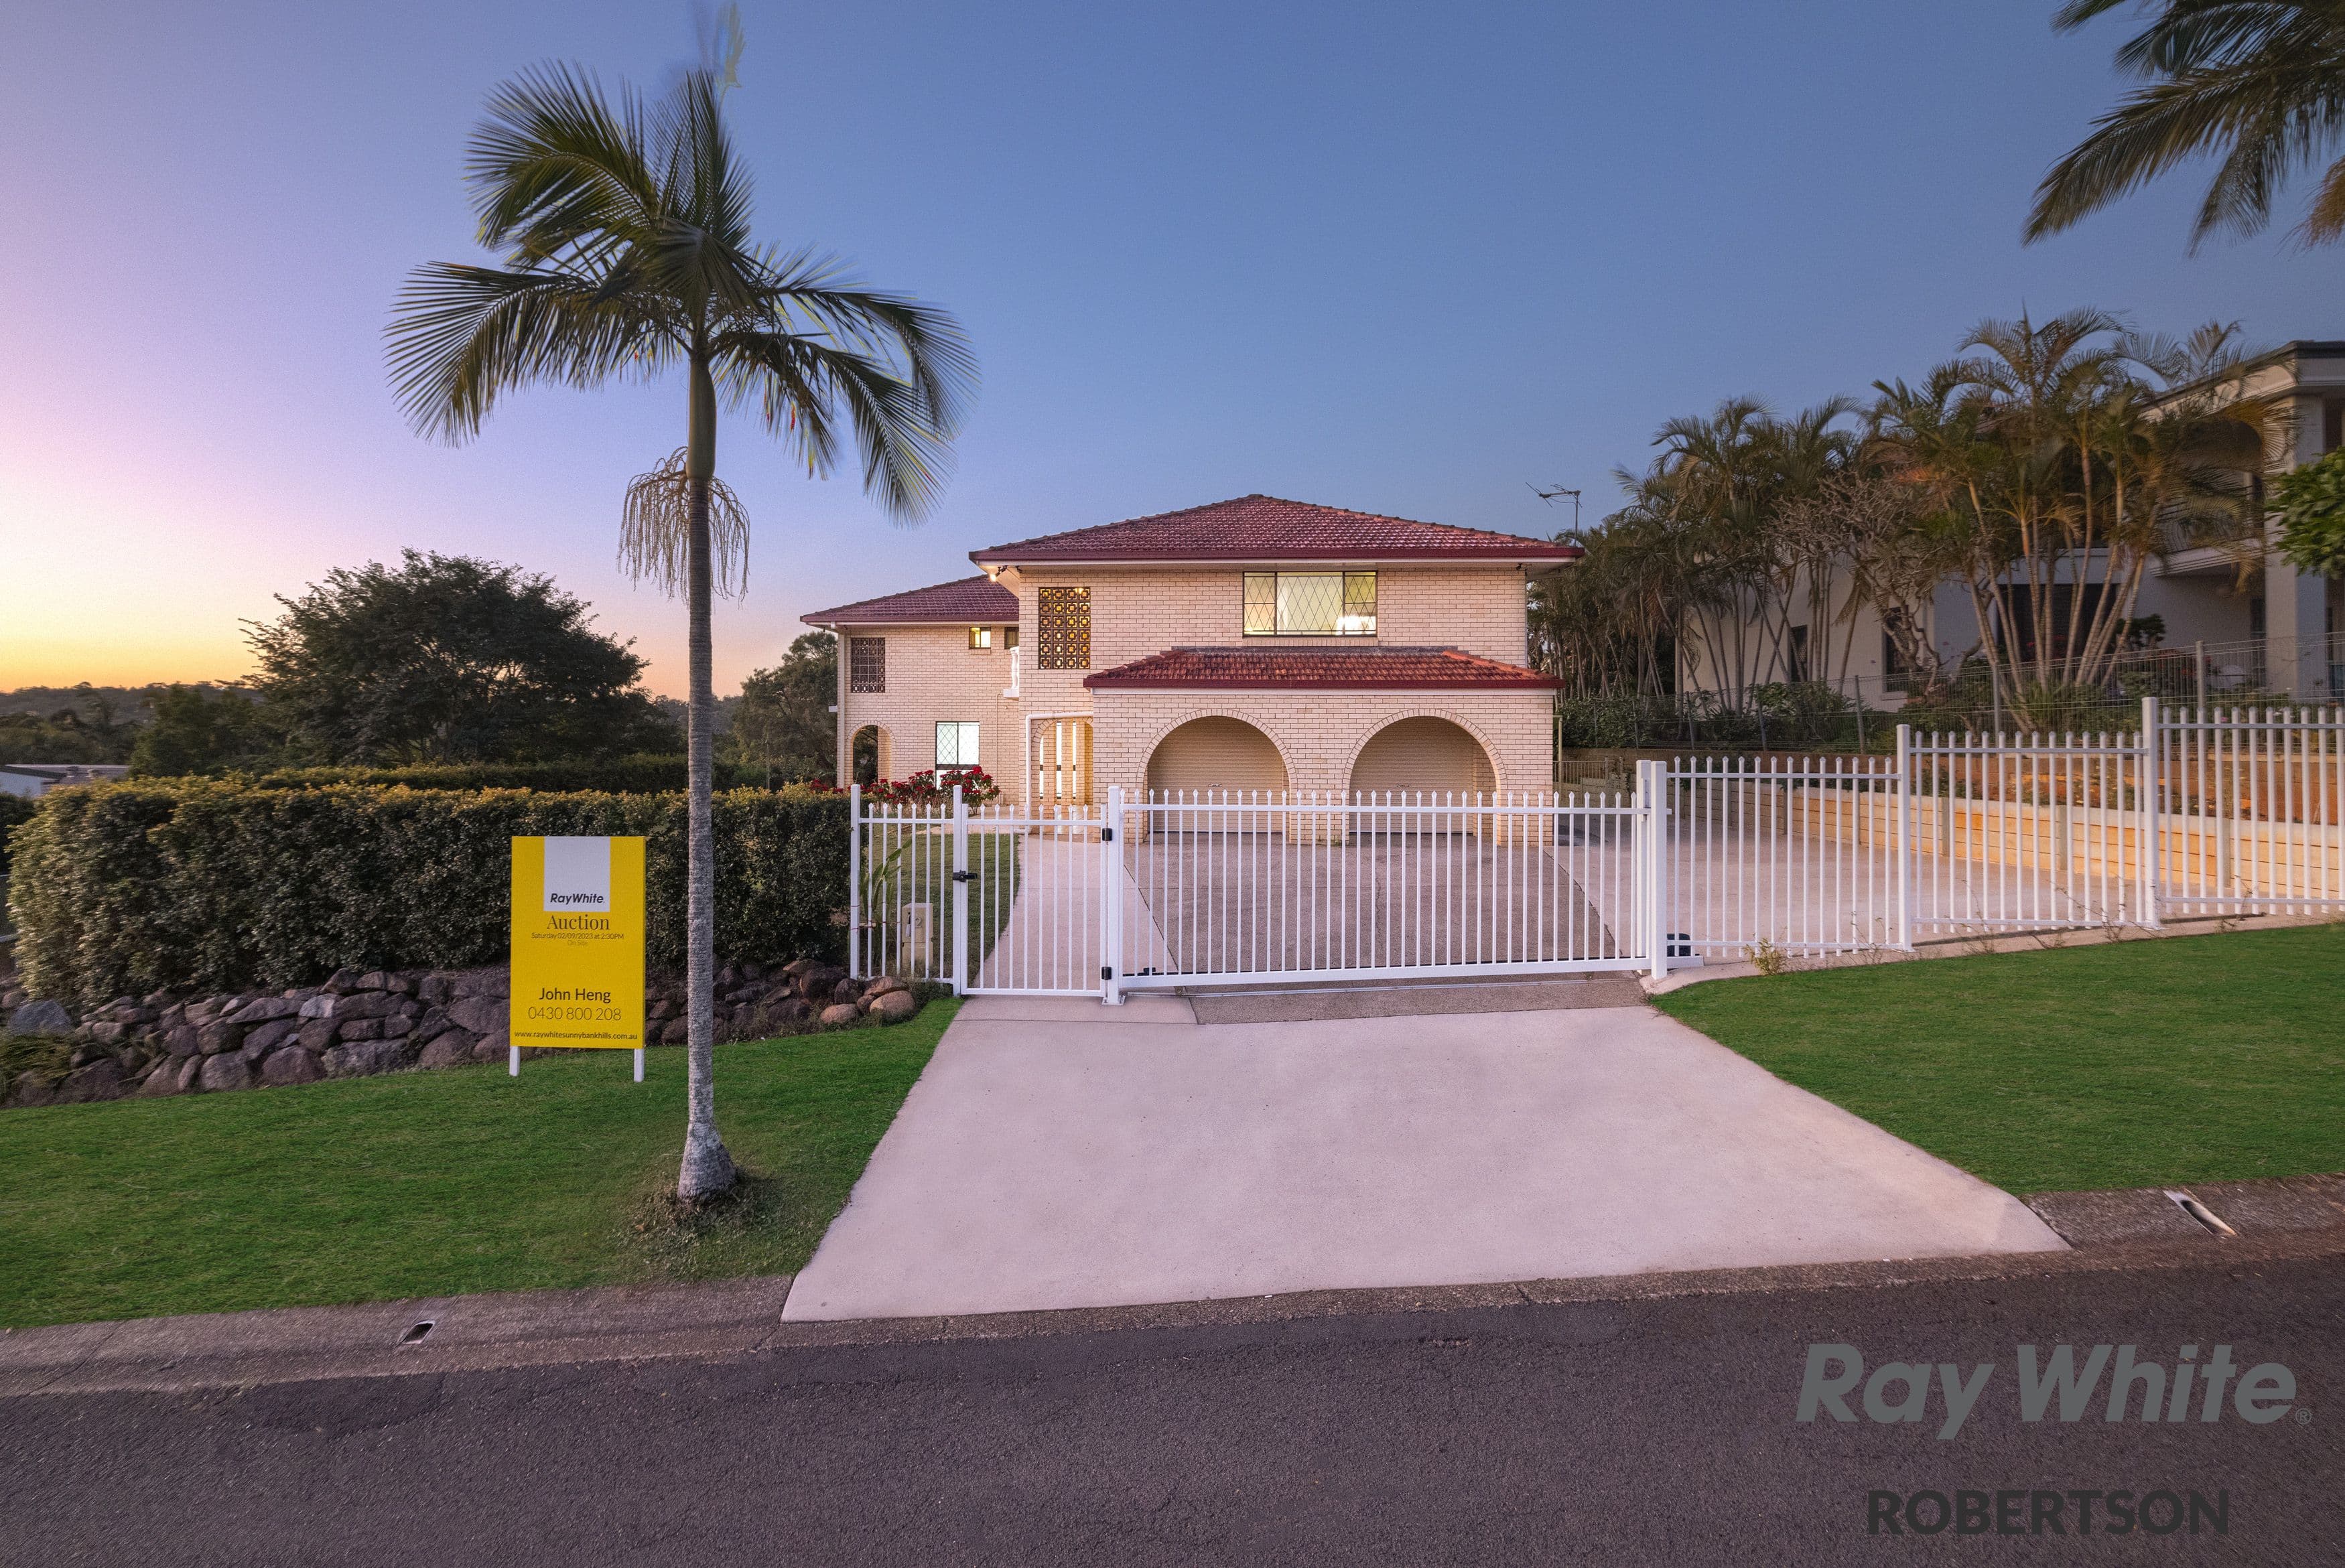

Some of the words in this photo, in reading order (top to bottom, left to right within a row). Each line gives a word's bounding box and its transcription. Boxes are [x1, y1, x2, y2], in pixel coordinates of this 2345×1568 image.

[547, 914, 610, 930] Auction
[531, 932, 557, 940] Saturday
[539, 987, 570, 1000] John
[576, 988, 611, 1004] Heng
[528, 1007, 563, 1019] 0430
[566, 1007, 592, 1020] 800
[596, 1008, 622, 1021] 208
[515, 1031, 638, 1040] www.raywhitesunnybankhills.com.au
